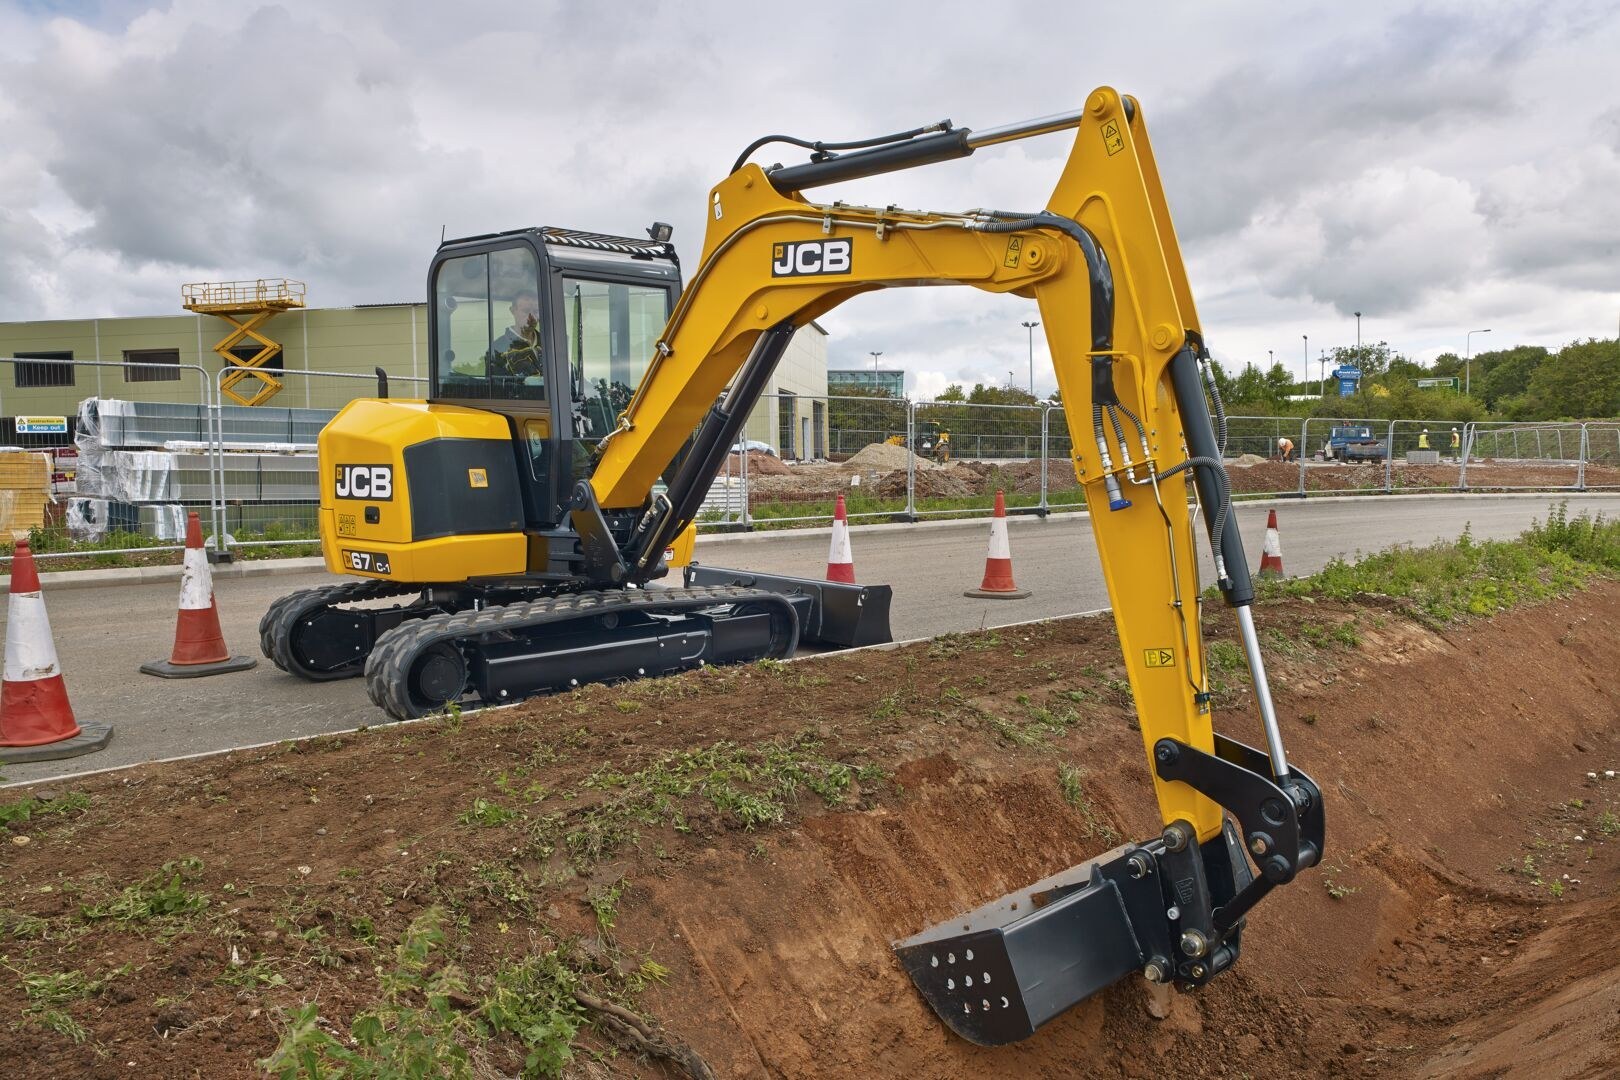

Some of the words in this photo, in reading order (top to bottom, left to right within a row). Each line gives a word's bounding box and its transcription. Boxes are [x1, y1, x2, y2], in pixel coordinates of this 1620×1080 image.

[774, 241, 850, 275] JCB
[336, 466, 392, 498] JCB
[351, 552, 371, 570] 67
[376, 562, 391, 573] C-1
